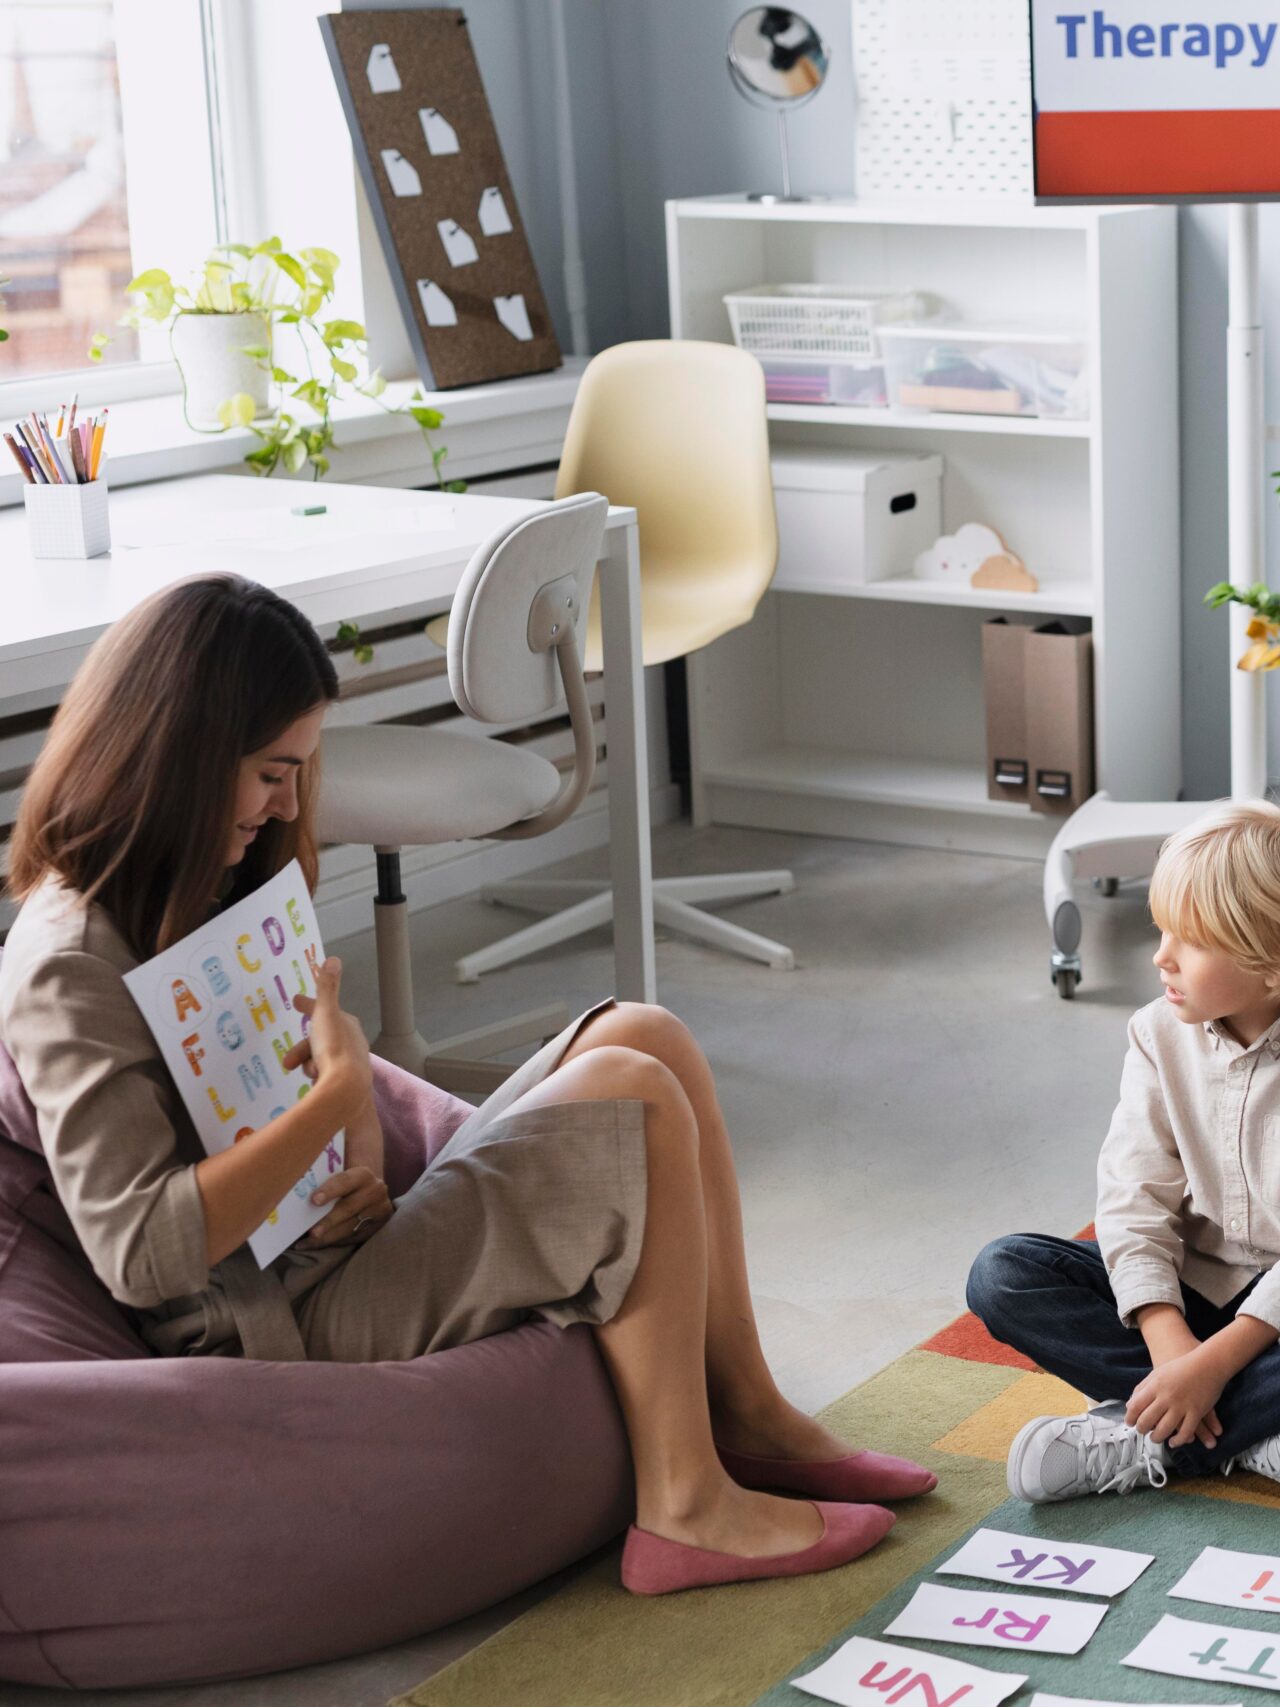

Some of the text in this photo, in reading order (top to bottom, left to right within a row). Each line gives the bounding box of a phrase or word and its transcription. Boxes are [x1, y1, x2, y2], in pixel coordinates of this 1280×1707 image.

[1056, 10, 1278, 68] Therapy
[171, 898, 305, 1023] A B C D E
[181, 1032, 206, 1077] F
[216, 1010, 245, 1051] G
[244, 987, 276, 1033] H
[273, 974, 292, 1011] I
[207, 1086, 237, 1124] L
[238, 1054, 273, 1102] M
[996, 1549, 1096, 1585] Kk
[952, 1607, 1051, 1642] Rr
[858, 1661, 974, 1707] Nn
[1189, 1637, 1278, 1680] Tt
